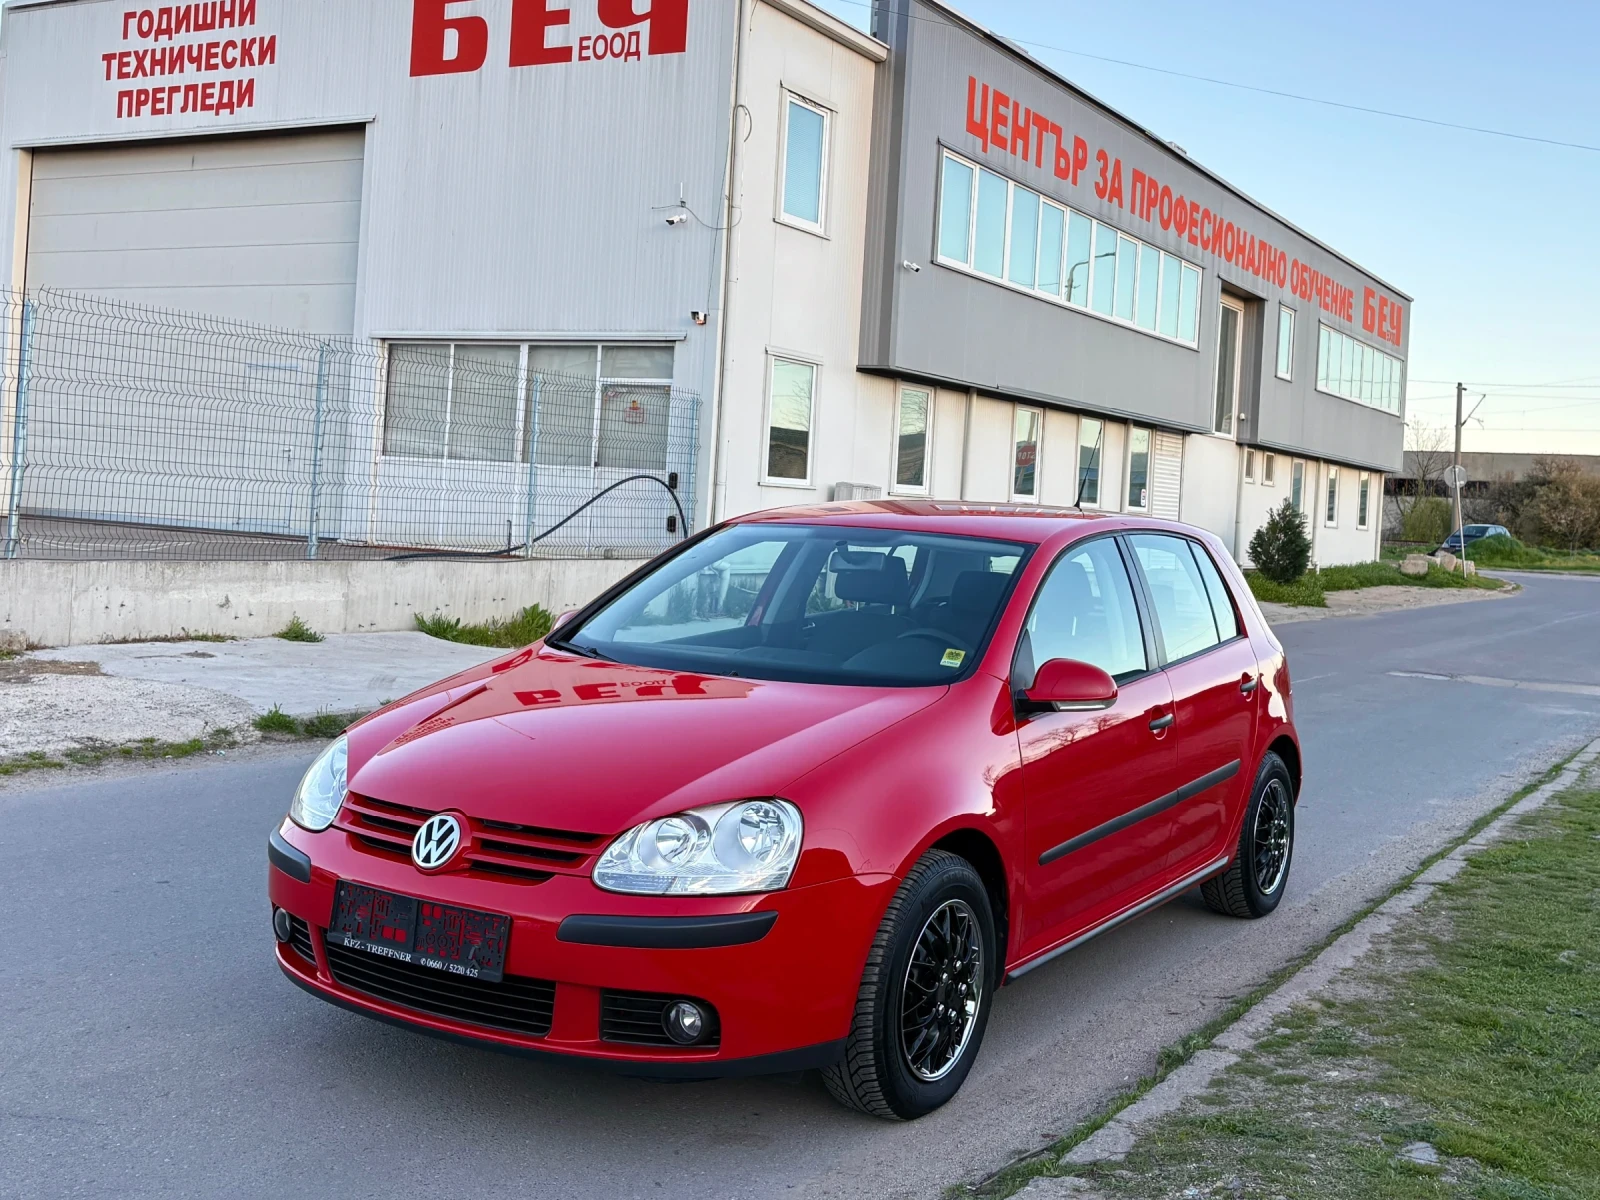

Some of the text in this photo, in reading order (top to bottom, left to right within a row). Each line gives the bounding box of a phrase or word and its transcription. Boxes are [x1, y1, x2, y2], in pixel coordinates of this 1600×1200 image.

[122, 0, 256, 42] ГОДИШНИ
[101, 35, 276, 81] ТЕХНИЧЕСКИ
[578, 31, 640, 62] ЕООД
[116, 78, 255, 118] ПРЕГЛЕДИ
[966, 75, 1402, 346] ЦЕНТЪР ЗА ПРОФЕСИОНАЛНО ОБУЧЕНИЕ БЕЧ
[413, 815, 460, 868] VW
[343, 937, 361, 950] KFZ
[366, 943, 412, 963] TREFFNER
[449, 964, 464, 975] 5220
[465, 966, 478, 978] 425
